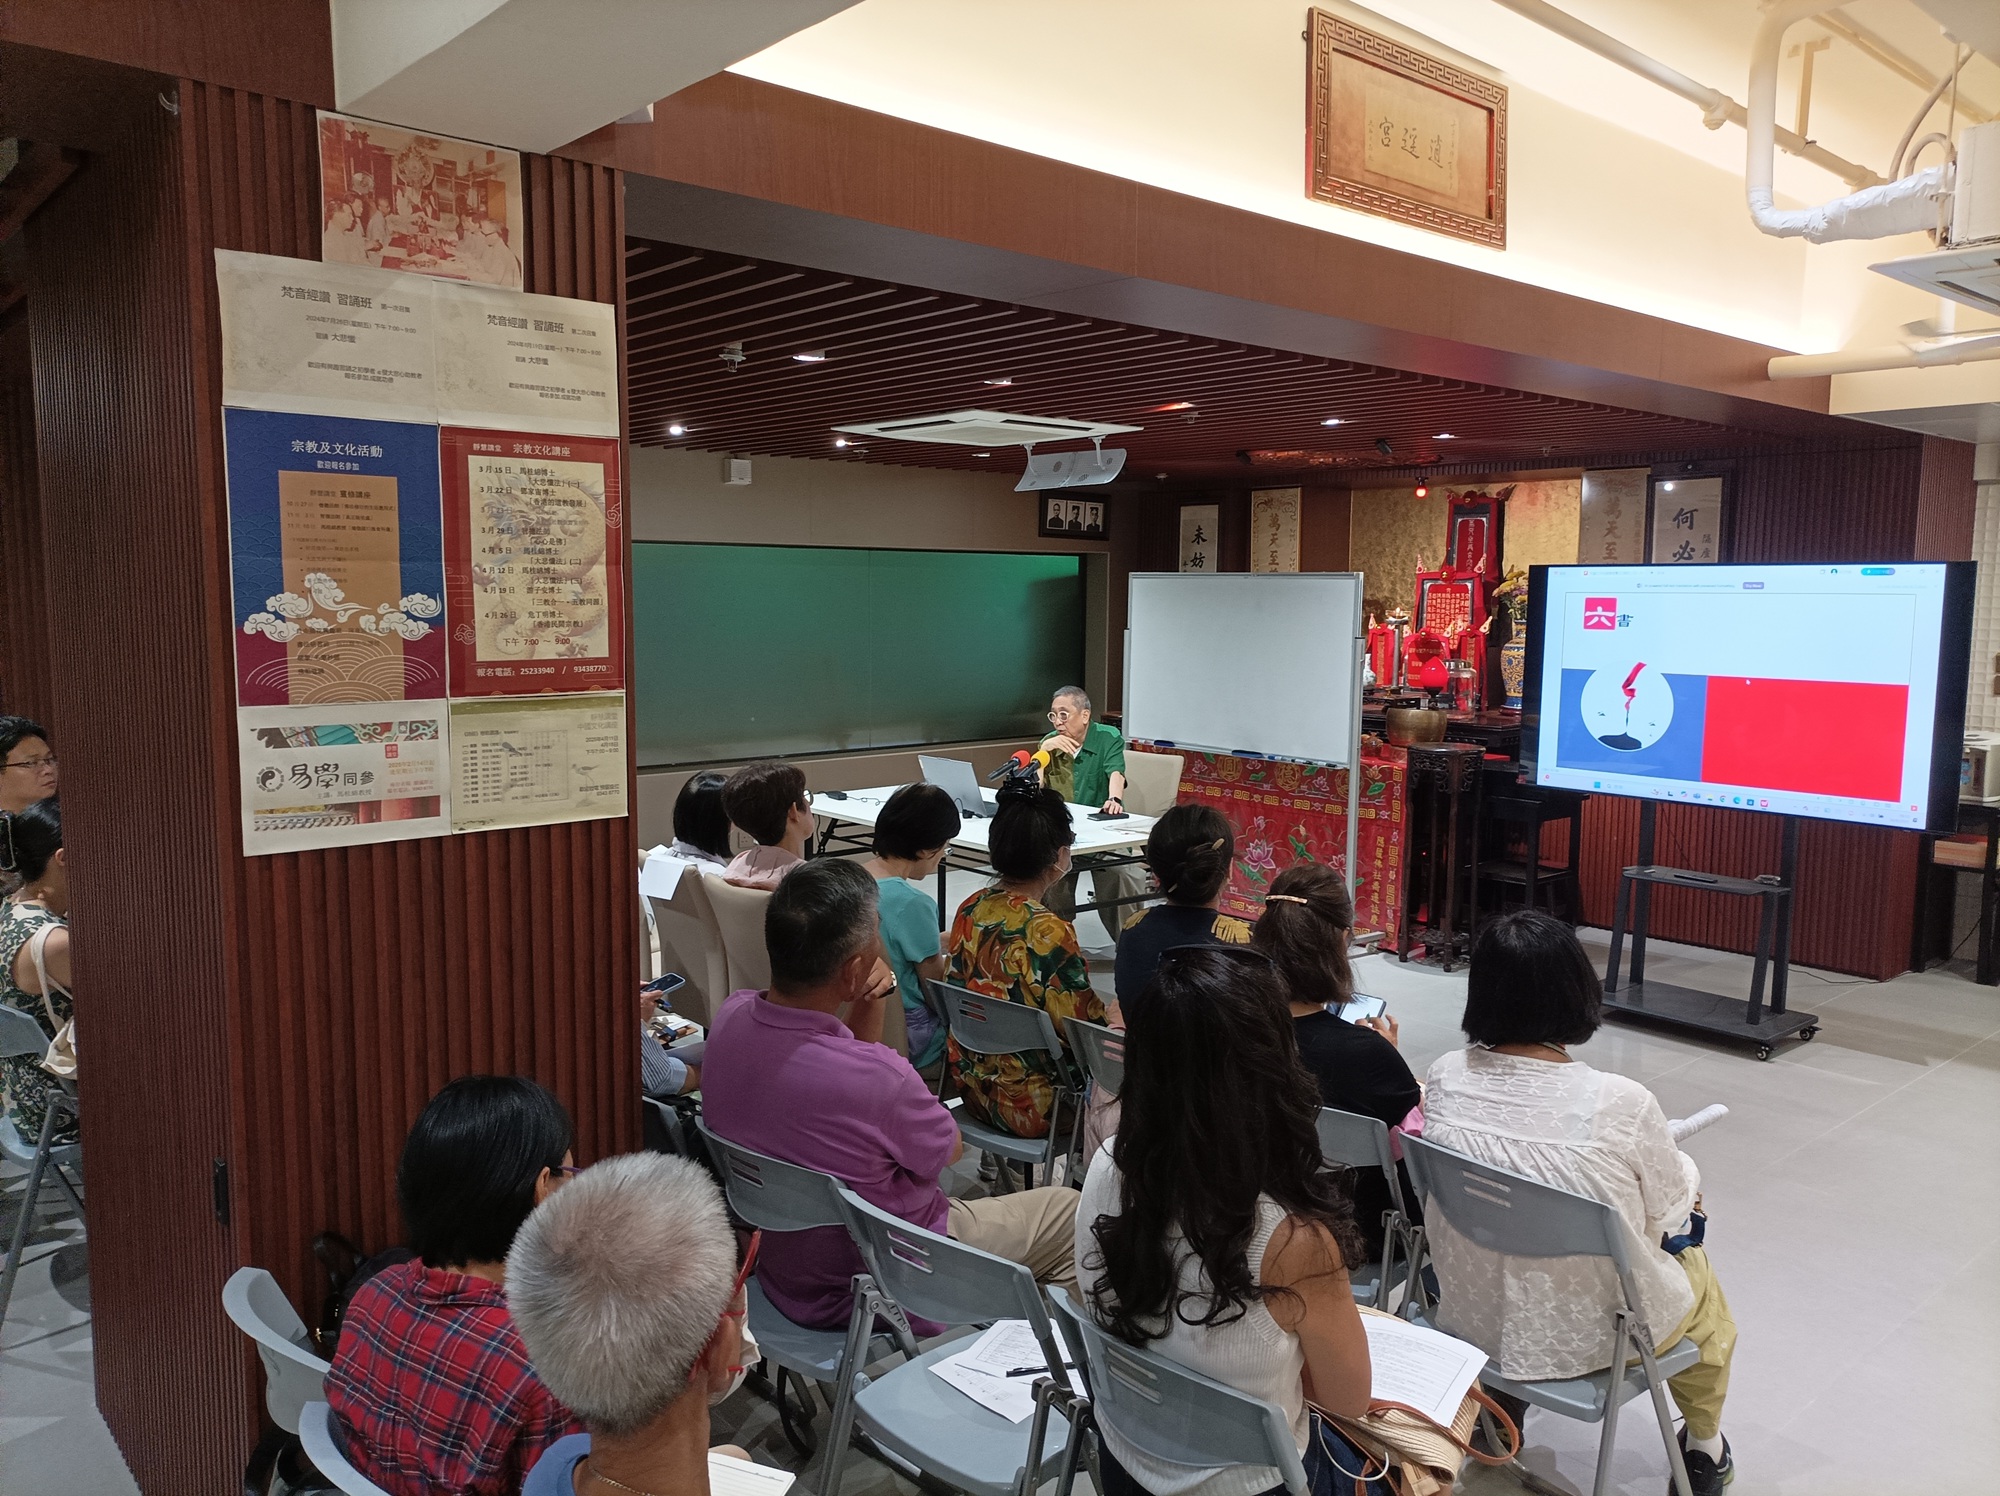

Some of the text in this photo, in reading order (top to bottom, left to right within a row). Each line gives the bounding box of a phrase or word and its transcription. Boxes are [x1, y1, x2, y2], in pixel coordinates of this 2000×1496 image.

[291, 439, 383, 458] 宗教及文化活動
[513, 443, 571, 457] 宗教文化講座
[1268, 513, 1281, 572] 萬天至
[1672, 507, 1699, 562] 何必
[1190, 524, 1208, 569] 未妨
[503, 638, 519, 646] 下午
[524, 638, 539, 646] 7:00
[520, 667, 555, 675] 25233940
